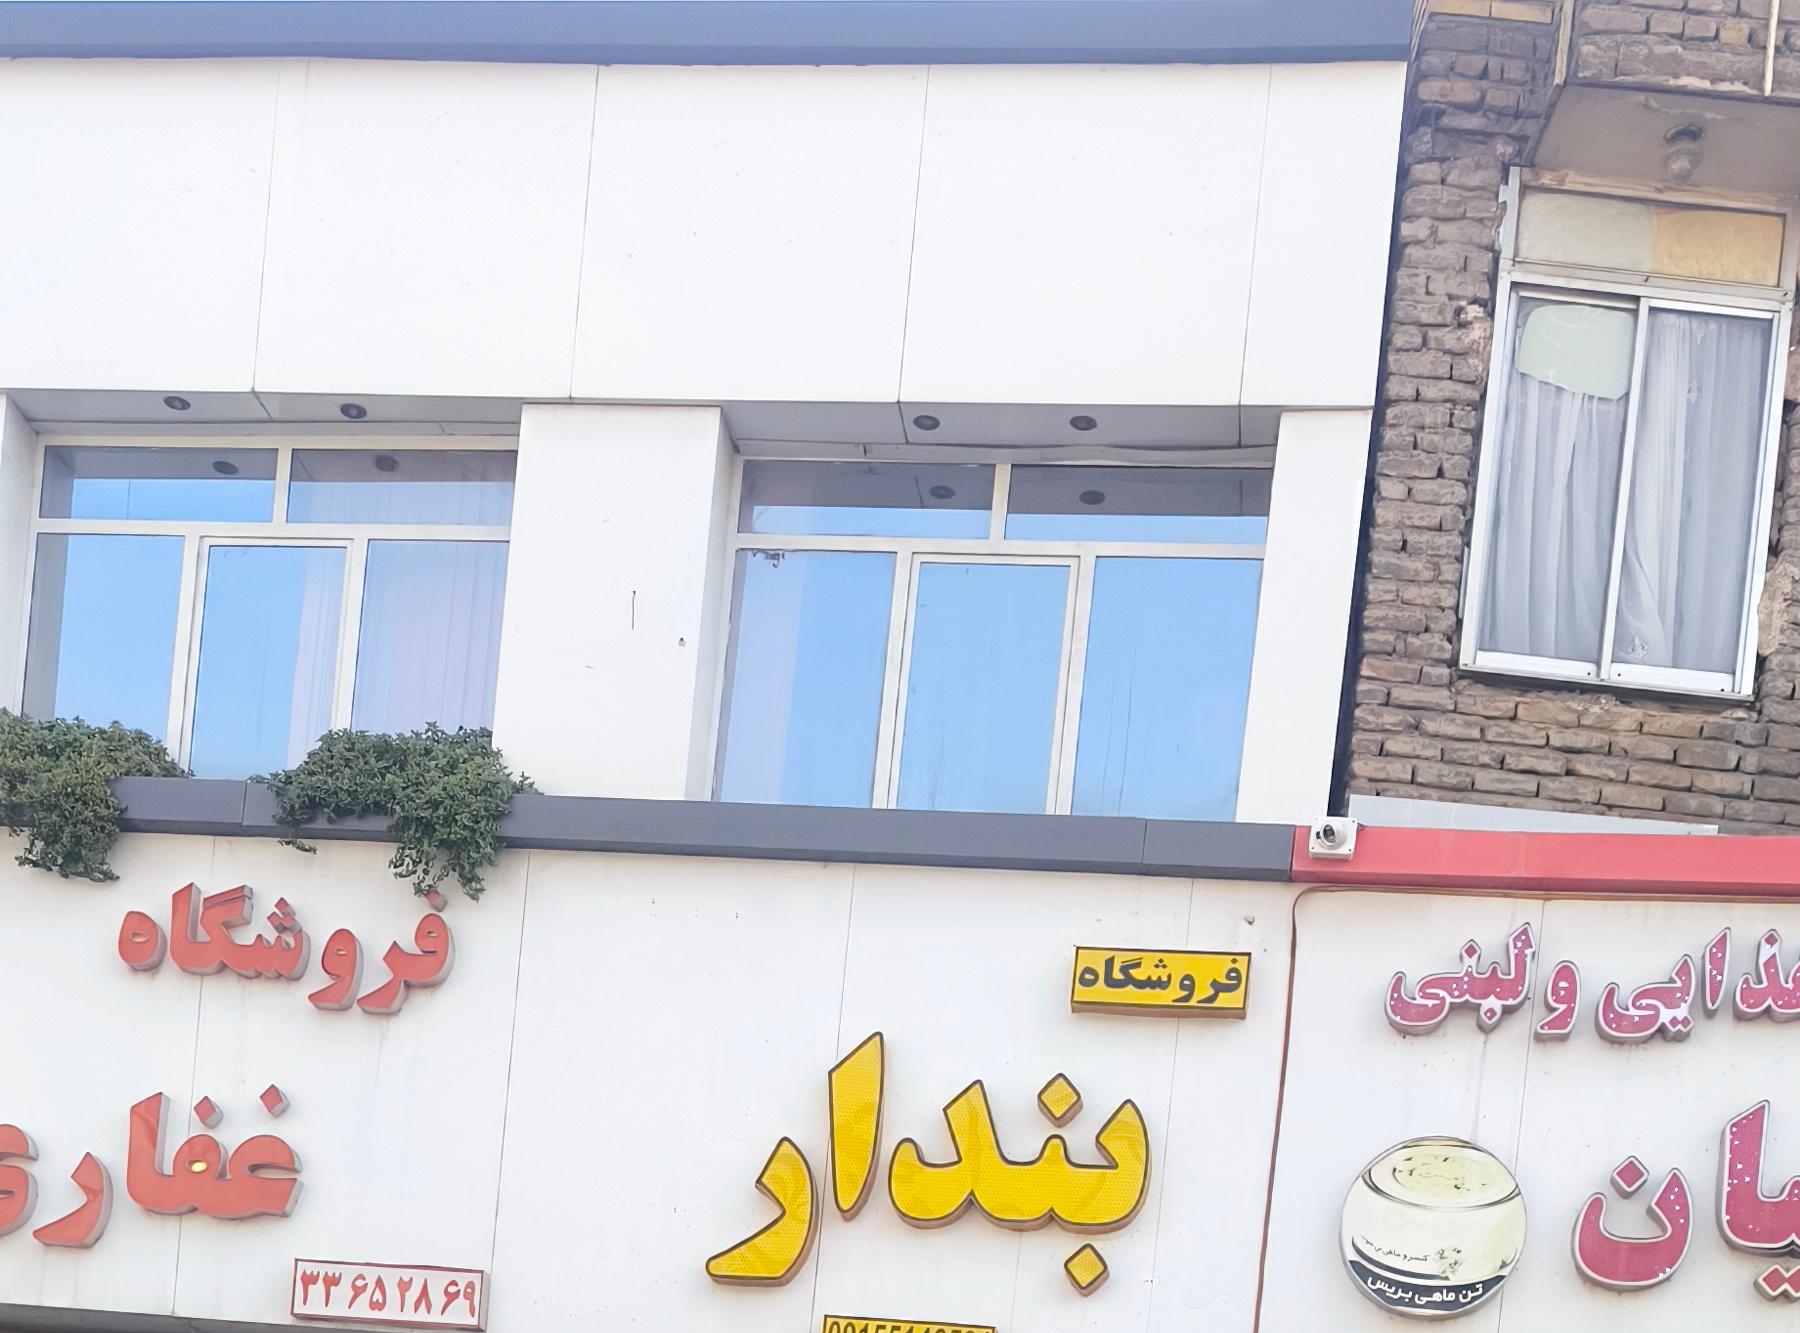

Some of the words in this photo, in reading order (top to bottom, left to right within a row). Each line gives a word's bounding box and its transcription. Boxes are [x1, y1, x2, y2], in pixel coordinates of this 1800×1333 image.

[118, 882, 454, 1014] فروشگاه
[1078, 954, 1243, 1004] فروشگاه
[1384, 920, 1535, 1036] لبنی
[1596, 926, 1800, 1046] ذایی
[1534, 958, 1580, 1041] و
[705, 1031, 1150, 1297] بندار
[1414, 1288, 1456, 1305] ماهی
[1459, 1283, 1483, 1303] تن
